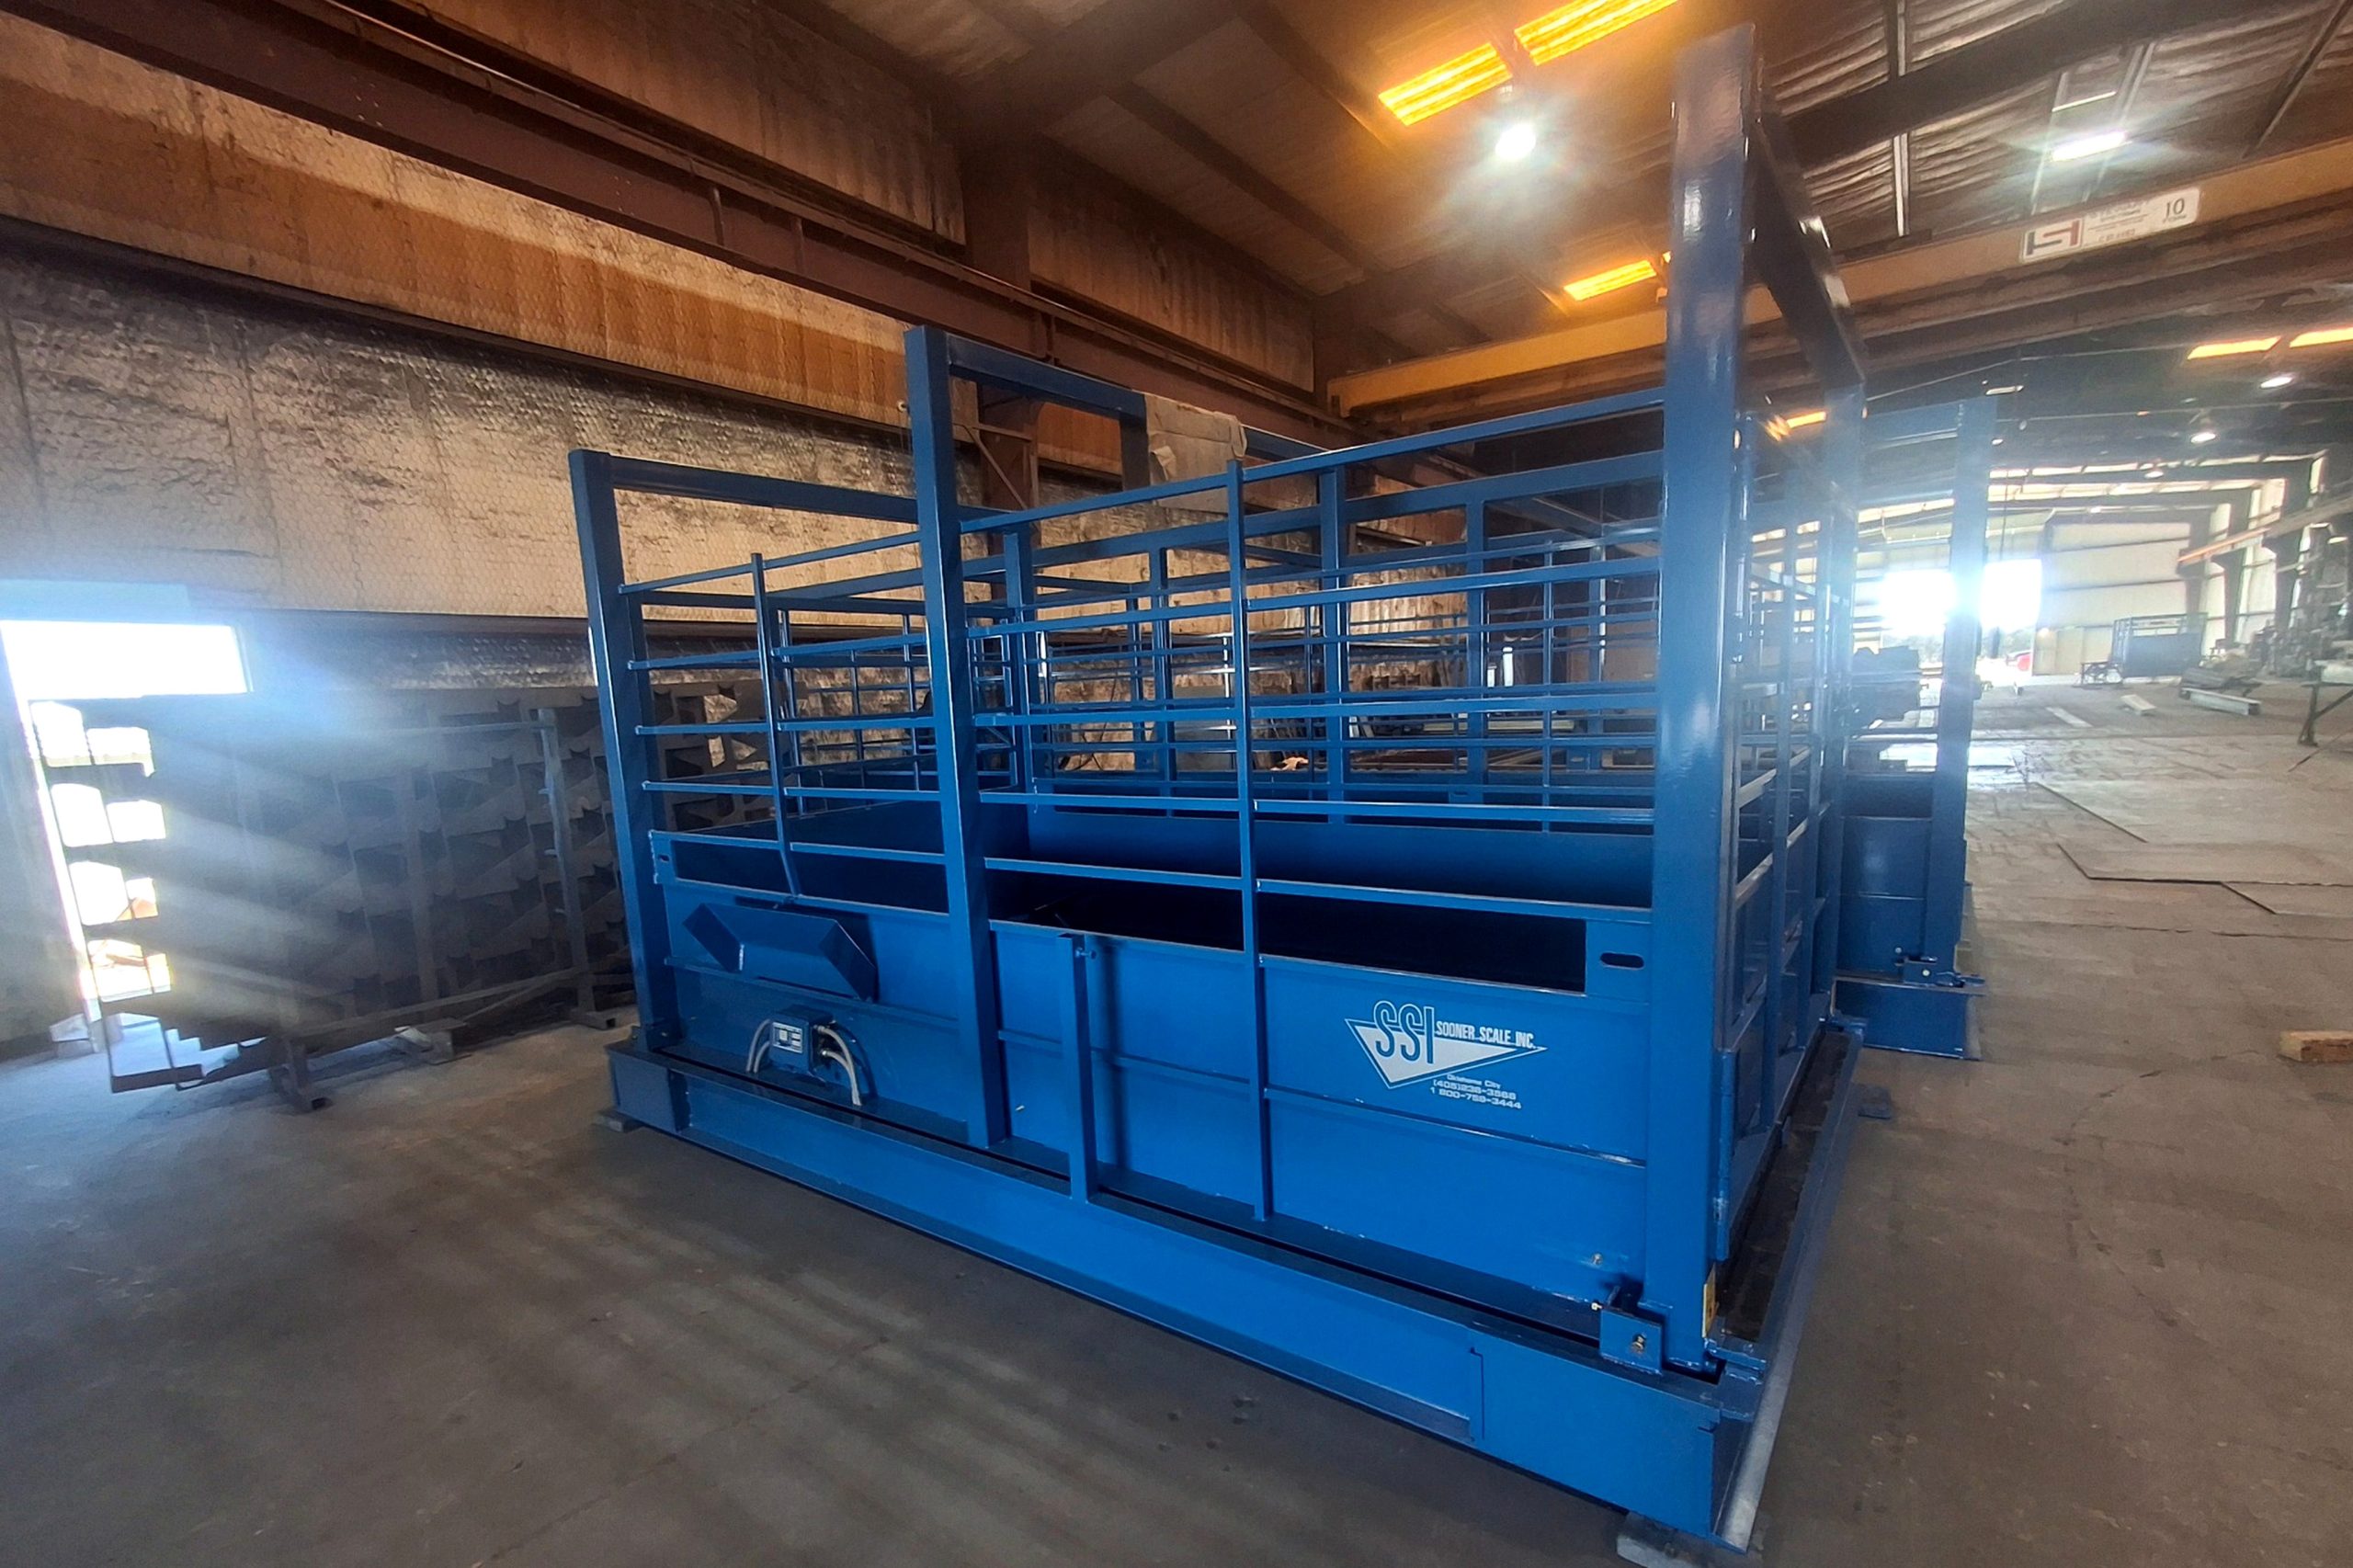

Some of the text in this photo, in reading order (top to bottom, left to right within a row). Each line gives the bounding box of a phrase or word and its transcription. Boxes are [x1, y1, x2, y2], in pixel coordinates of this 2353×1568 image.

[2165, 197, 2186, 219] 10
[1372, 1000, 1435, 1065] SSI
[1435, 1020, 1536, 1050] SOONER SCALE INC.
[1484, 1080, 1501, 1089] City
